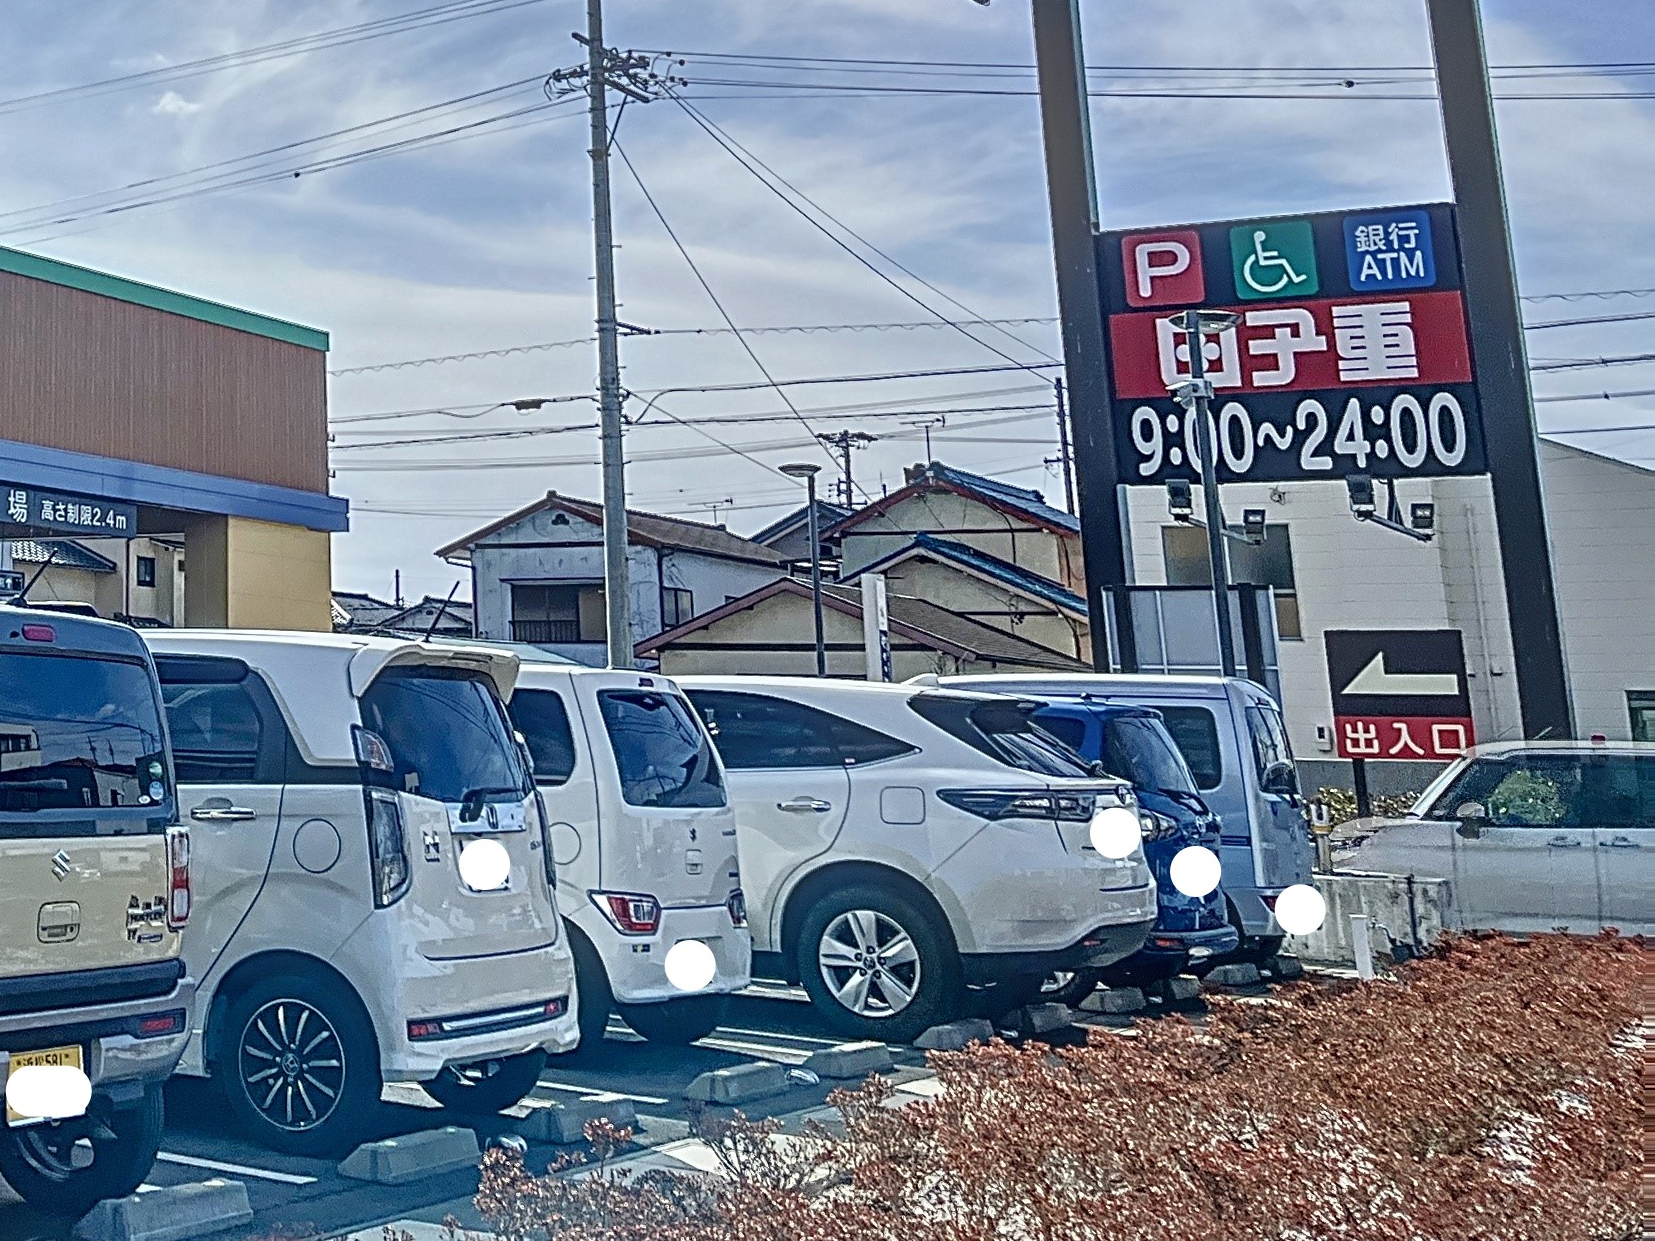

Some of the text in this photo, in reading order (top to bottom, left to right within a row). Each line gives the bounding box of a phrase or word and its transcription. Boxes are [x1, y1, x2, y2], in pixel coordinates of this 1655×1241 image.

[1354, 222, 1420, 252] 銀行
[1135, 242, 1190, 298] P
[1360, 251, 1424, 281] ATM
[41, 500, 127, 530] 高さ制限2.4m
[1345, 721, 1466, 755] 出入口
